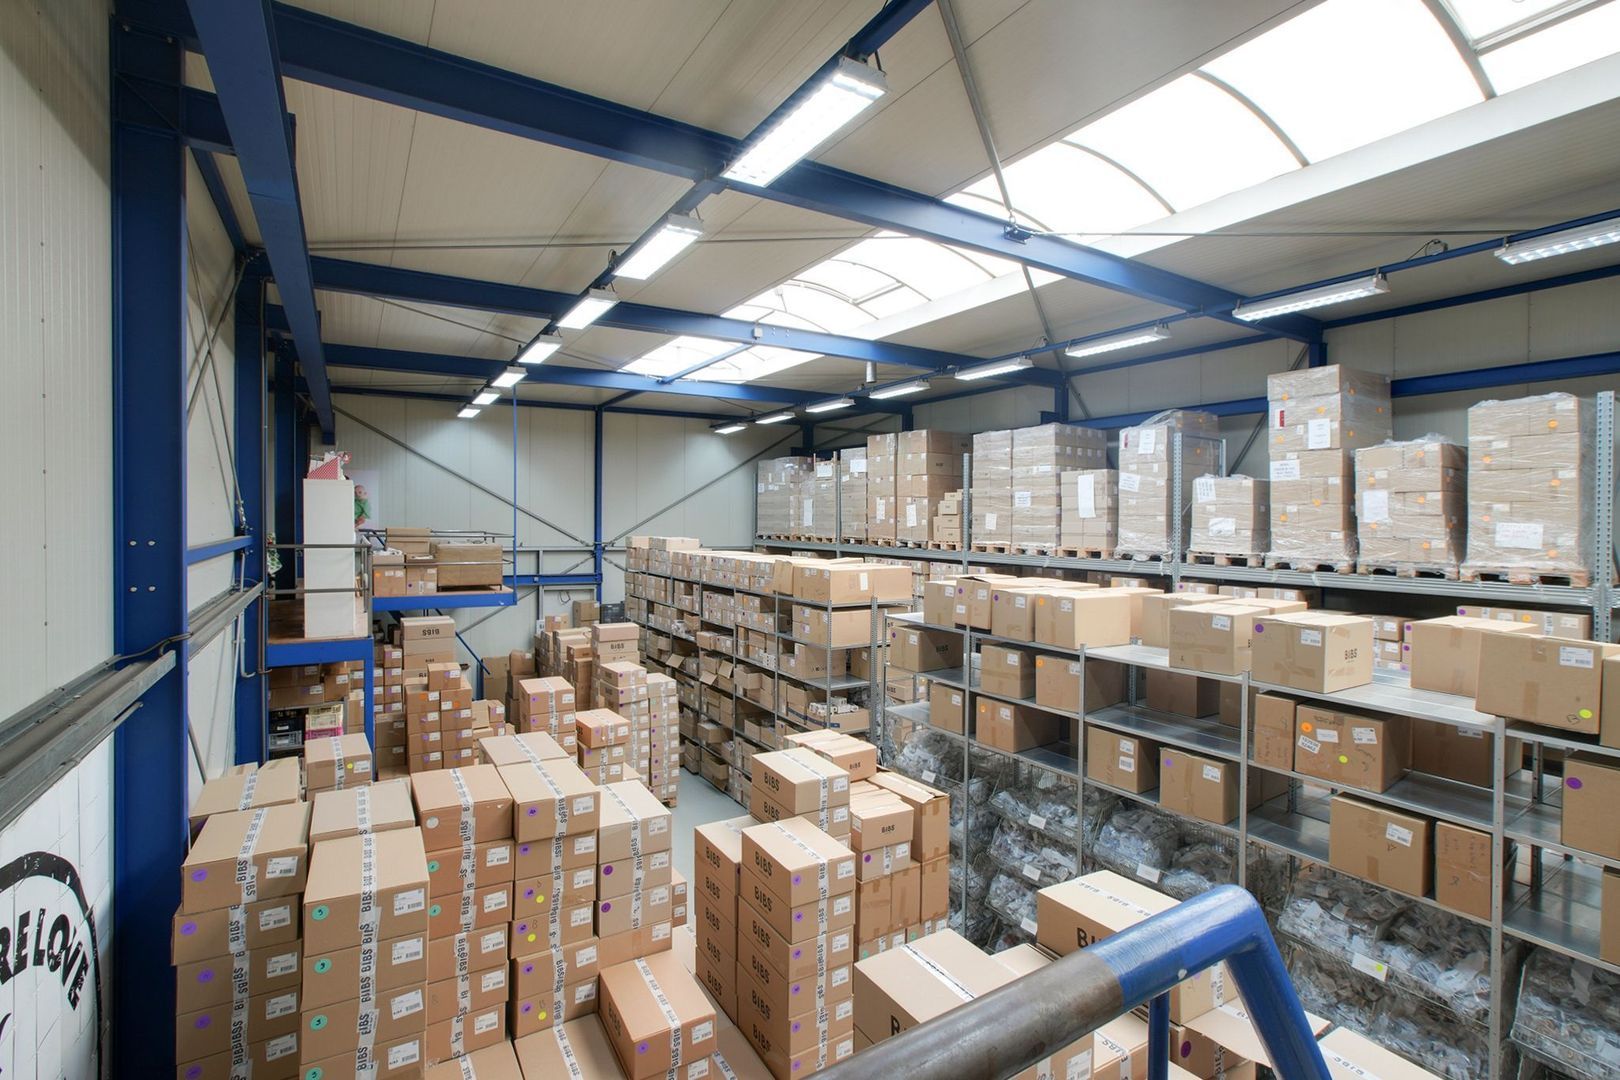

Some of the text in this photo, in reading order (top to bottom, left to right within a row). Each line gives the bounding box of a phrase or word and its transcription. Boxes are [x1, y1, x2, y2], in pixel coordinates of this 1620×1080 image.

[1344, 648, 1358, 660] BIBS
[764, 772, 780, 791] BIBS
[764, 802, 780, 820] BIBS
[881, 825, 895, 833] BIBS
[706, 847, 720, 868] BIBS
[755, 850, 772, 877] BIBS
[236, 860, 248, 882] BIBS
[706, 877, 720, 899] BIBS
[754, 886, 772, 912] BIBS
[361, 890, 373, 912] BIBS
[461, 896, 470, 915] BIBS
[706, 907, 720, 930] BIBS
[230, 920, 240, 944] BIBS
[752, 920, 770, 948] BIBS
[361, 949, 373, 972] BIBS
[706, 938, 720, 962] BIBS
[752, 955, 770, 984] BIBS
[707, 970, 722, 996] BIBS
[752, 990, 770, 1020] BIBS
[673, 1028, 681, 1048] BIBS
[752, 1024, 770, 1053] BIBS
[356, 1046, 368, 1070] BIBS
[672, 1048, 680, 1068] BIBS
